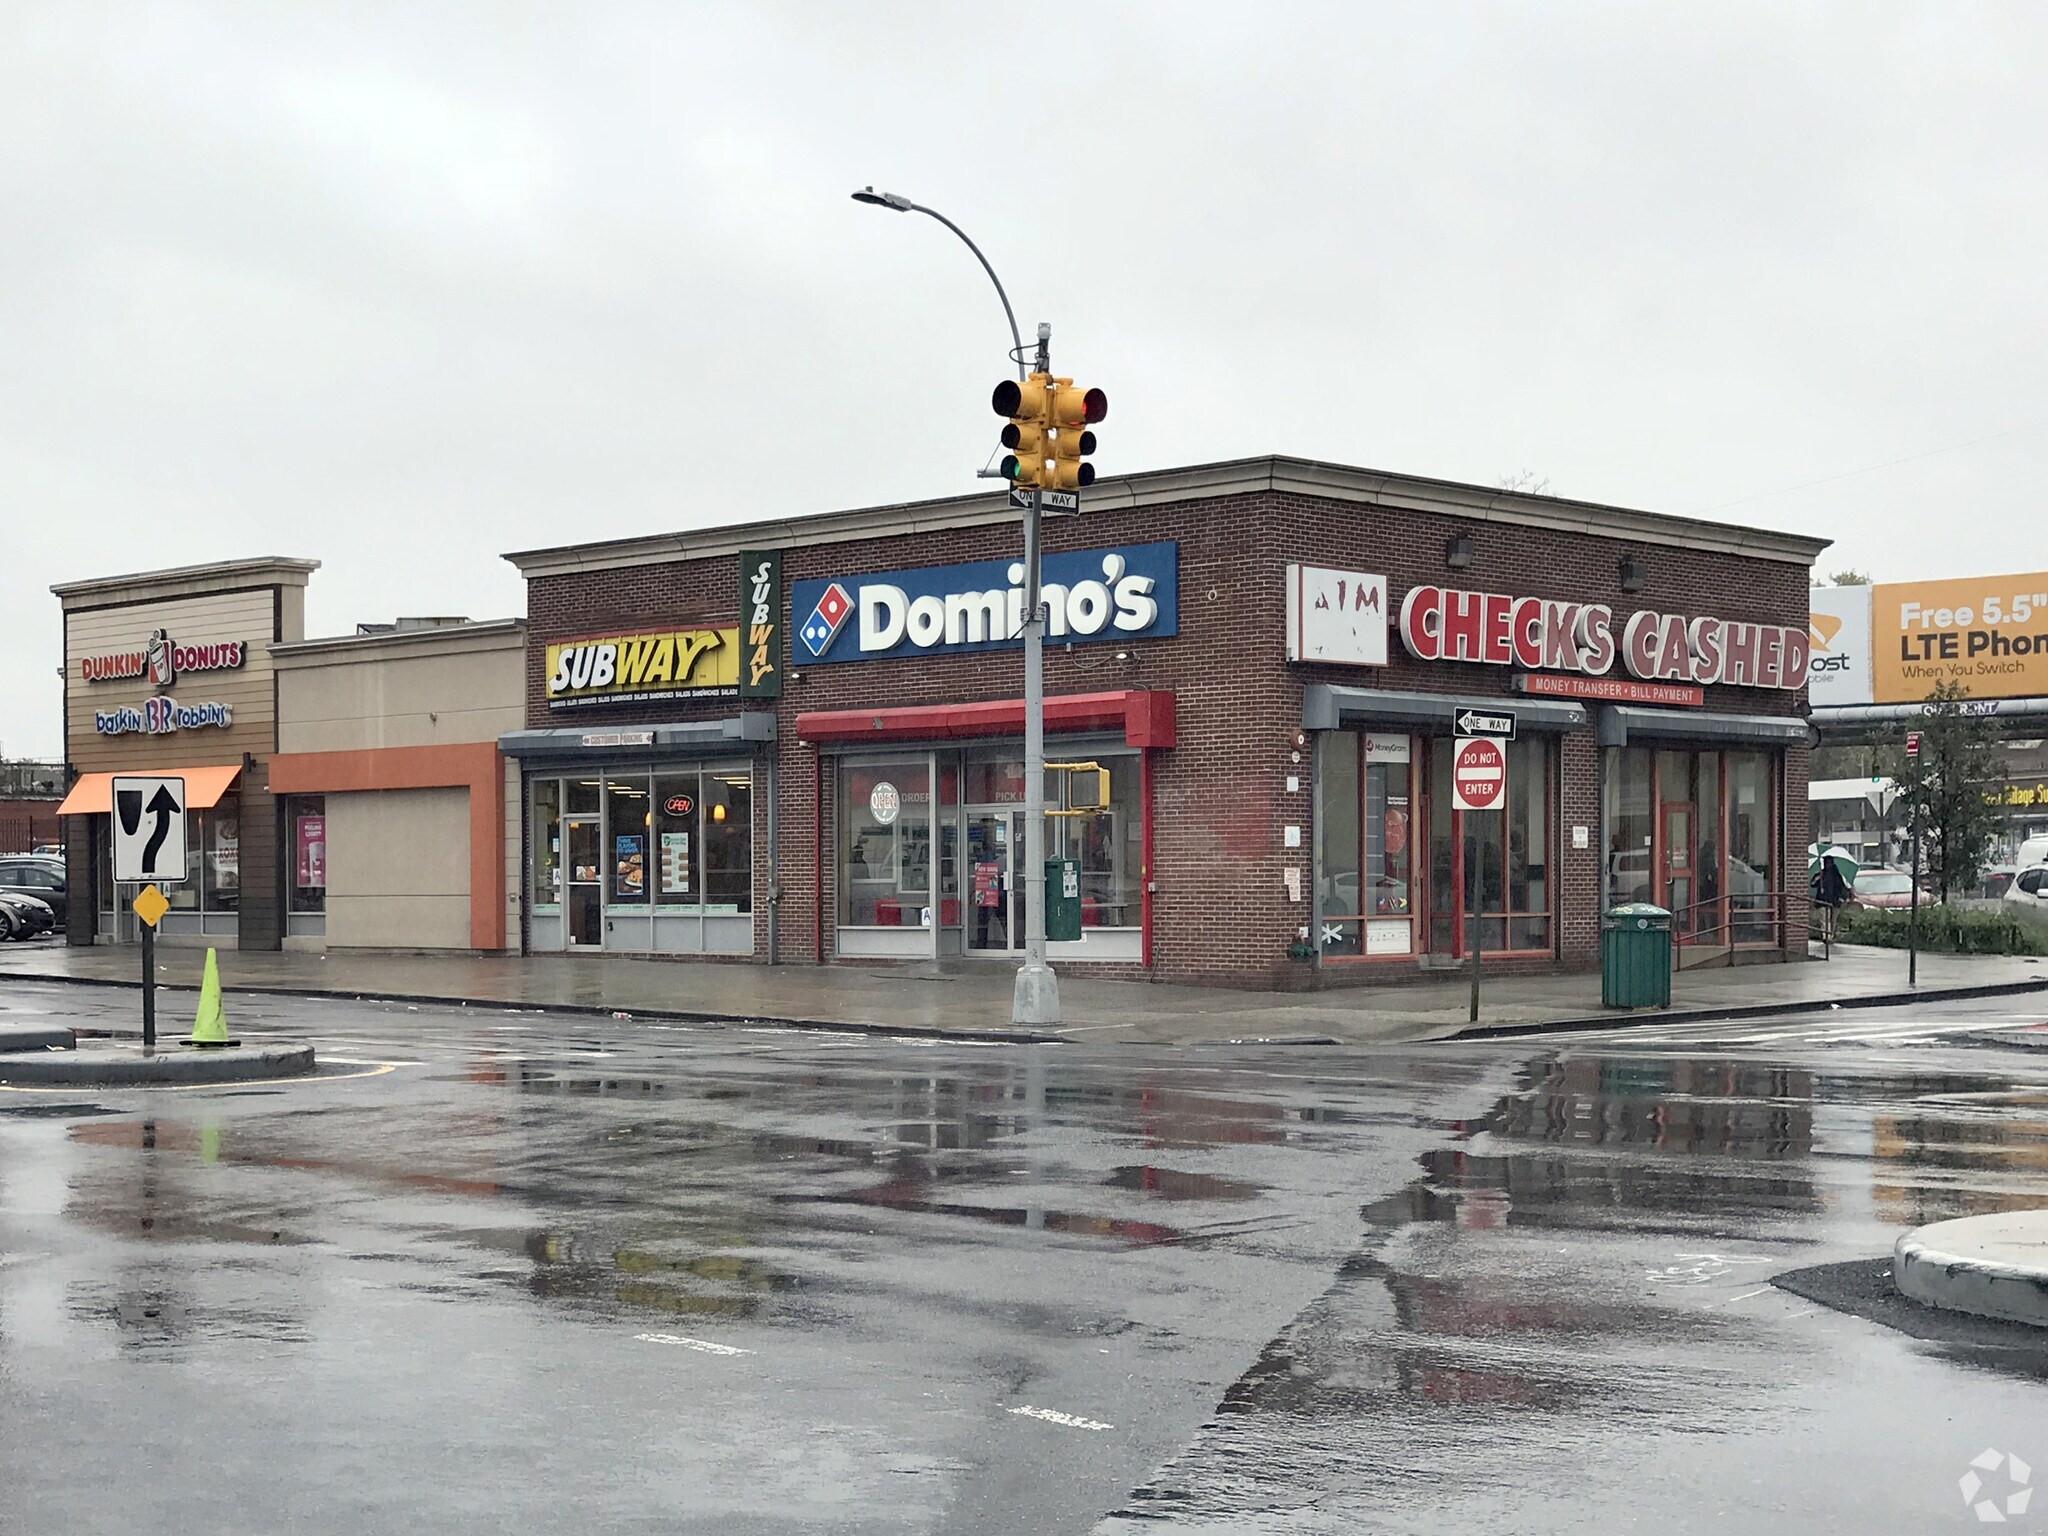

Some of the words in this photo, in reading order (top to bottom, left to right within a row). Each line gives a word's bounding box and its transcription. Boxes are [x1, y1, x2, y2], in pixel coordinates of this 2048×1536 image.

[1051, 494, 1071, 506] WAY
[858, 553, 1160, 652] Domino's
[1901, 602, 1974, 630] Free
[1982, 592, 2047, 626] 5.5"
[749, 561, 774, 687] SUBWAY
[1401, 585, 1616, 675] CHECKS
[1624, 610, 1810, 690] CASHED
[1901, 632, 1959, 662] LTE
[82, 652, 147, 680] DUNKIN'
[174, 642, 241, 671] DONUTS
[548, 630, 721, 694] SUBWAY
[1810, 652, 1850, 671] ost
[1902, 665, 1943, 679] When
[1947, 662, 1974, 676] You
[1976, 660, 2025, 676] Switch
[1535, 678, 1570, 693] MONEY
[1573, 681, 1622, 696] TRANSFER
[1630, 686, 1651, 699] BILL
[1653, 688, 1694, 702] PAYMENT
[96, 709, 141, 732] baskin
[176, 704, 226, 730] robbins
[1463, 717, 1481, 729] ONE
[1489, 720, 1508, 731] WAY
[1375, 742, 1407, 753] MoneyGram
[1464, 753, 1478, 765] DO
[1479, 752, 1497, 764] NOT
[995, 792, 1017, 802] PICK
[1465, 783, 1494, 795] ENTER
[872, 792, 897, 810] OPEN
[554, 870, 560, 880] A
[923, 909, 930, 920] A
